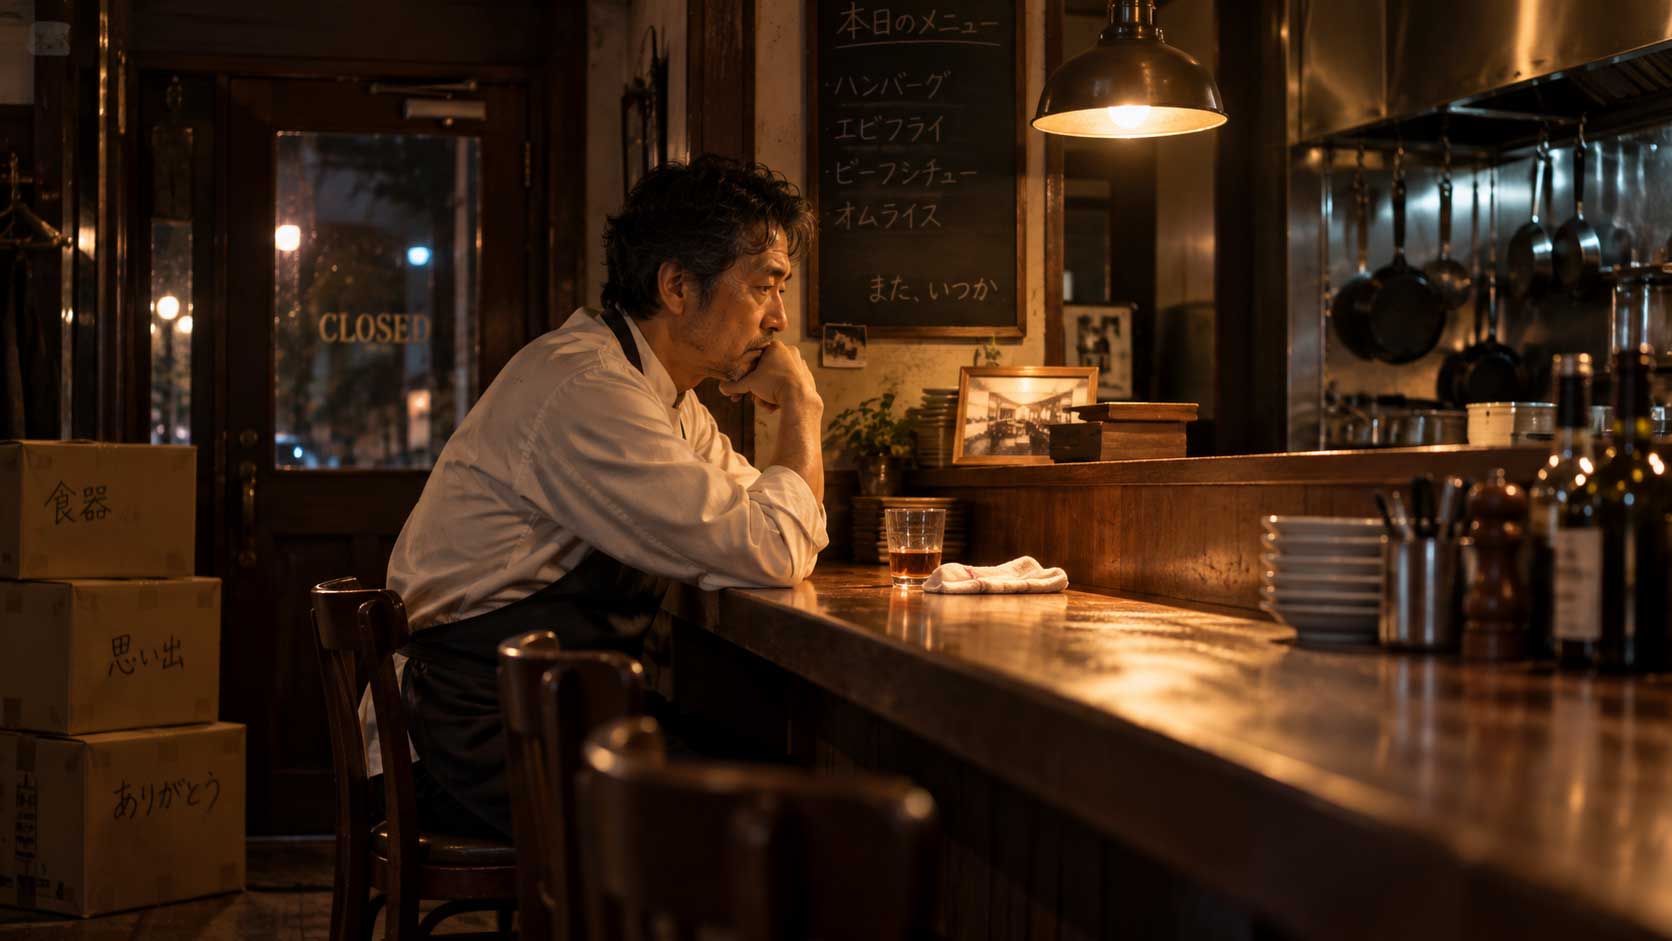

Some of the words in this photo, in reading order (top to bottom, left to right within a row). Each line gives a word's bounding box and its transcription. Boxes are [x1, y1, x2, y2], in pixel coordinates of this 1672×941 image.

[835, 3, 999, 40] 本日のメニュー
[834, 71, 952, 99] ハンバーグ
[834, 115, 944, 142] エビフライ
[836, 158, 977, 187] ビーフシチュー
[834, 201, 942, 229] オムライス
[868, 274, 999, 303] また、いつか
[319, 312, 432, 344] CLOSED
[44, 480, 112, 525] 食器
[108, 634, 184, 677] 思い出
[112, 772, 222, 820] ありがとう
